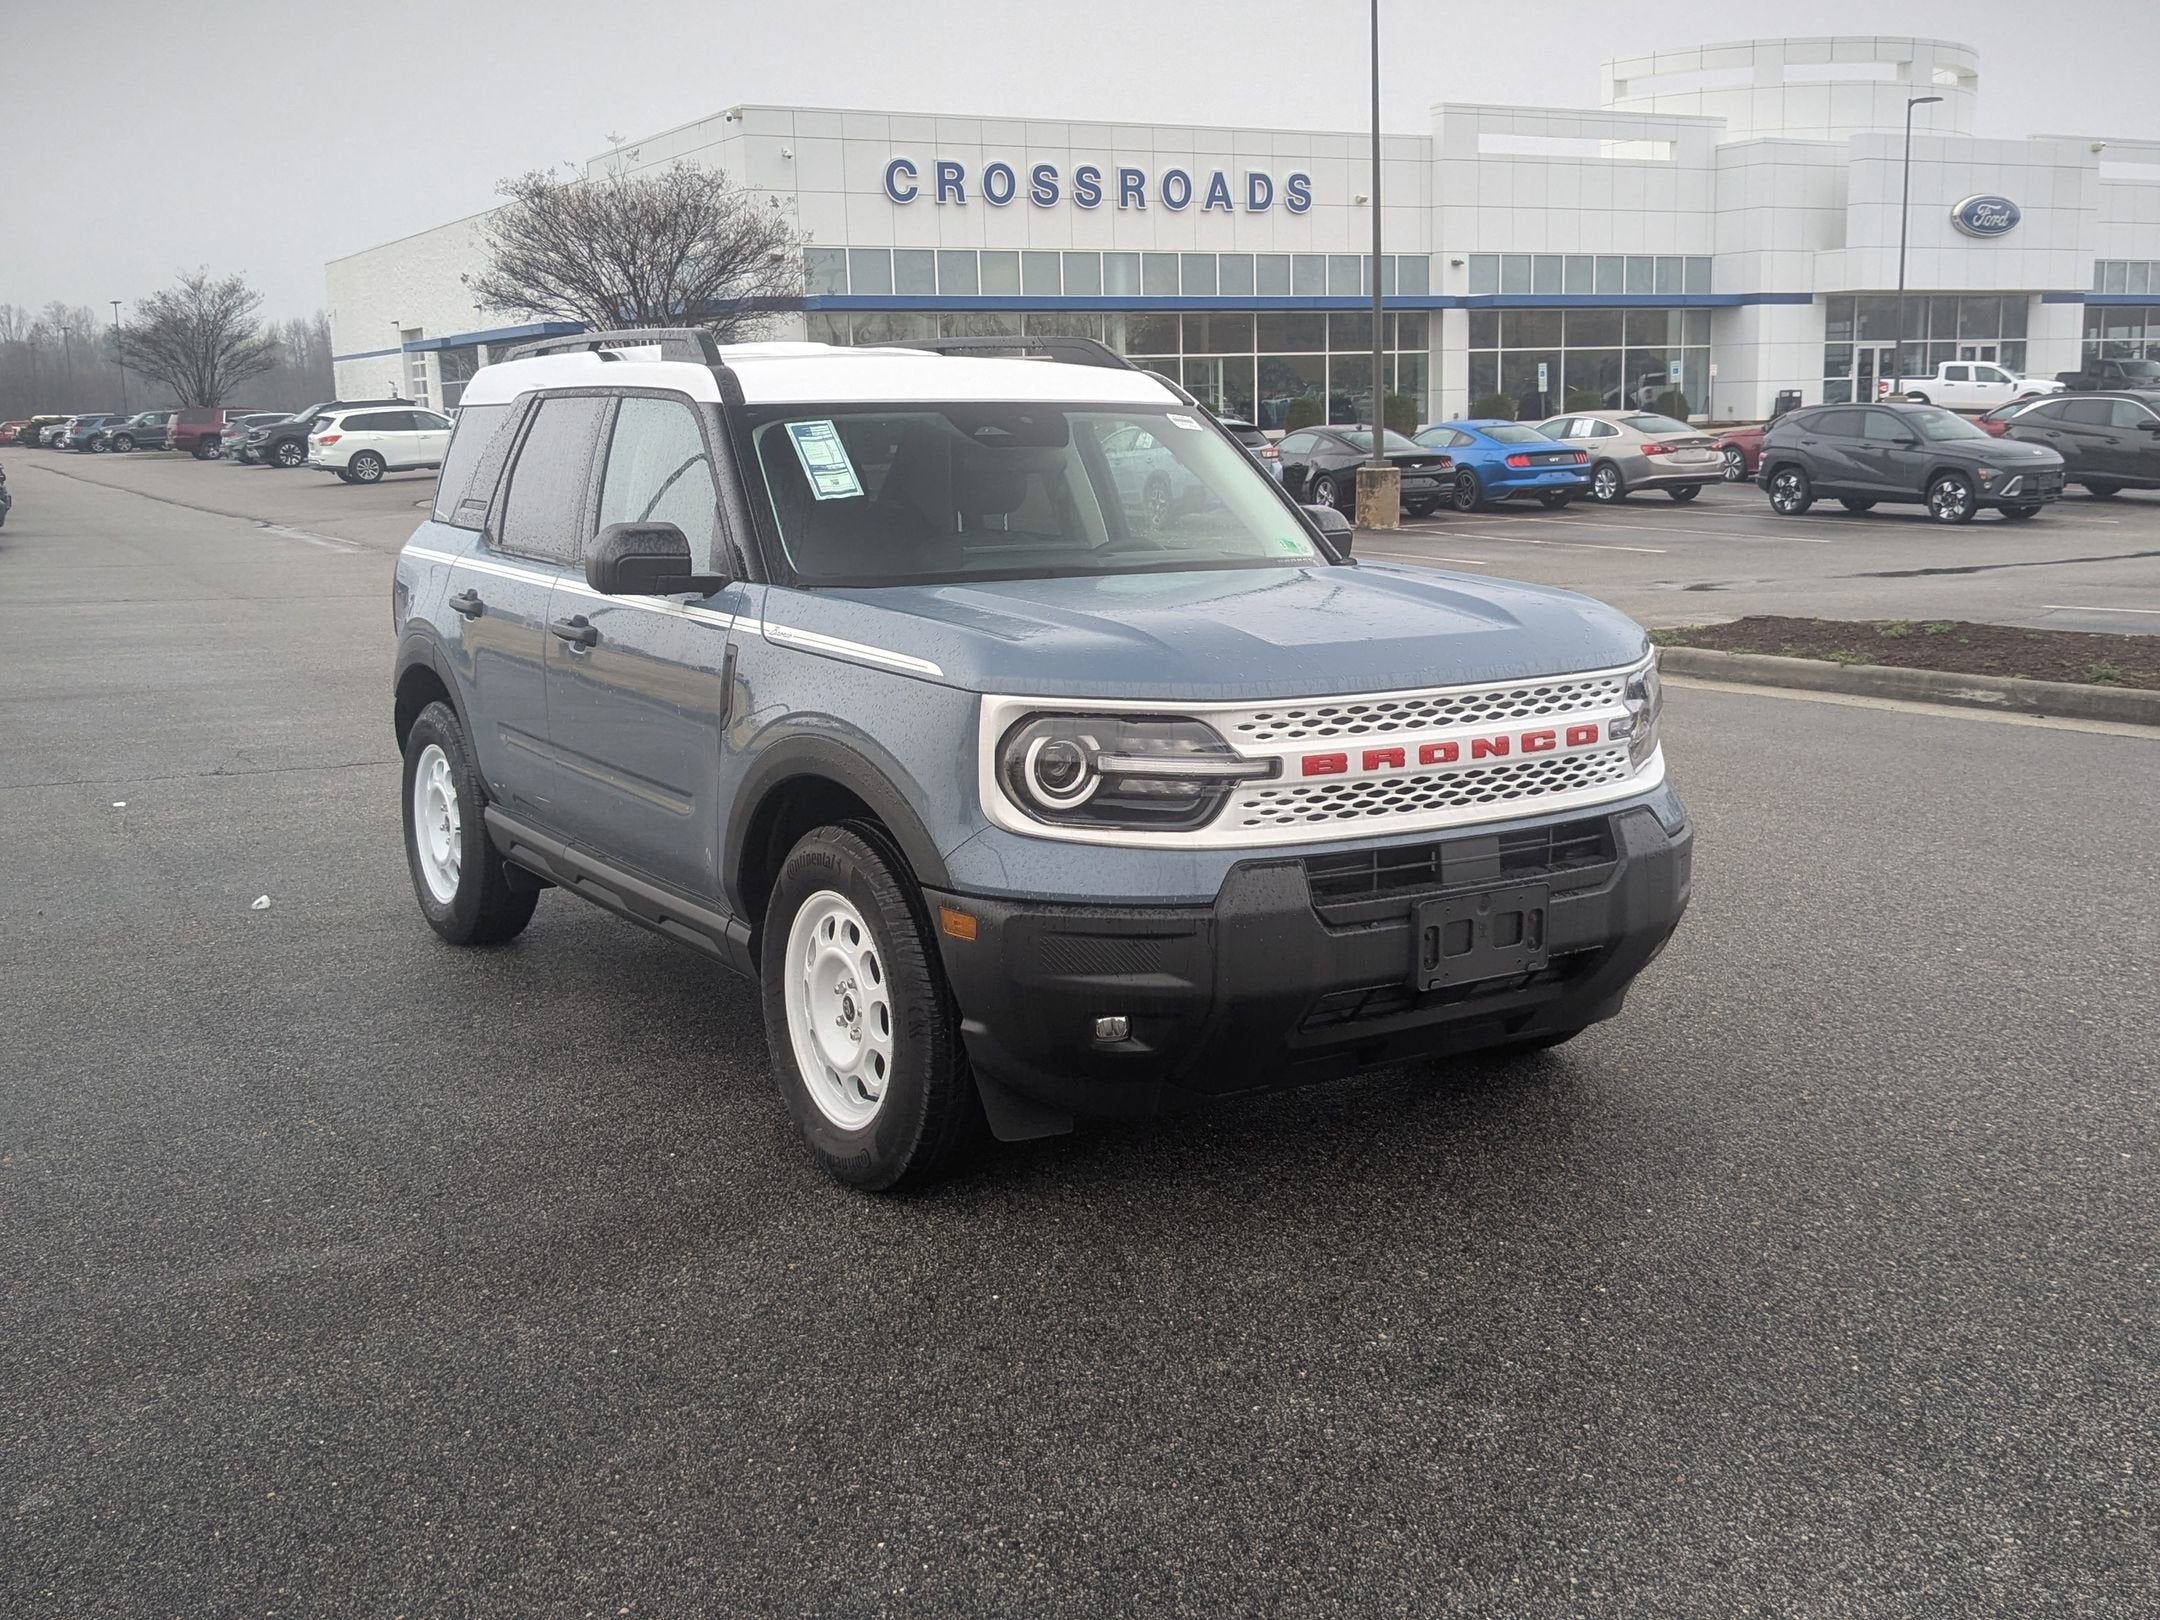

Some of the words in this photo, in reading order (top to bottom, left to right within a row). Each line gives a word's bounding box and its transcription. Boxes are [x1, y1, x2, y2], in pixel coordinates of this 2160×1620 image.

[884, 157, 1314, 214] CROSSROADS
[1972, 204, 2011, 227] Ford
[1301, 723, 1599, 777] BRONCO
